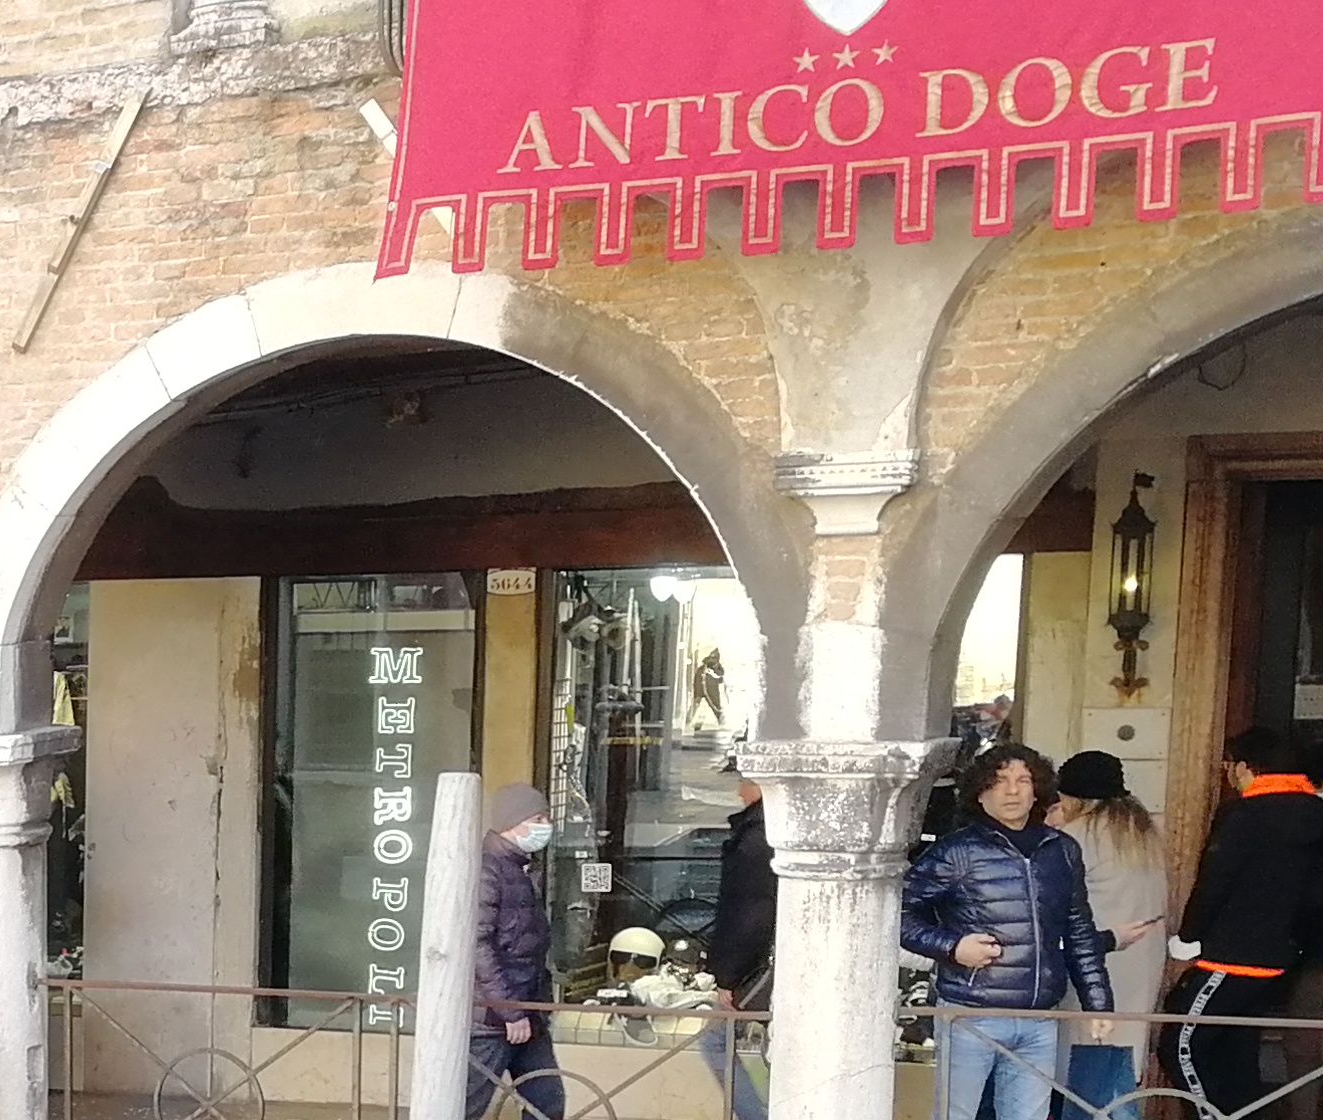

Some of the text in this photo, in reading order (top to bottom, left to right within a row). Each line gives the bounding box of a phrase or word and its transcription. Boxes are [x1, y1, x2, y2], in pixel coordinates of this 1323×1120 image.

[496, 36, 1219, 174] ANTICO DOGE
[490, 577, 533, 590] 5644
